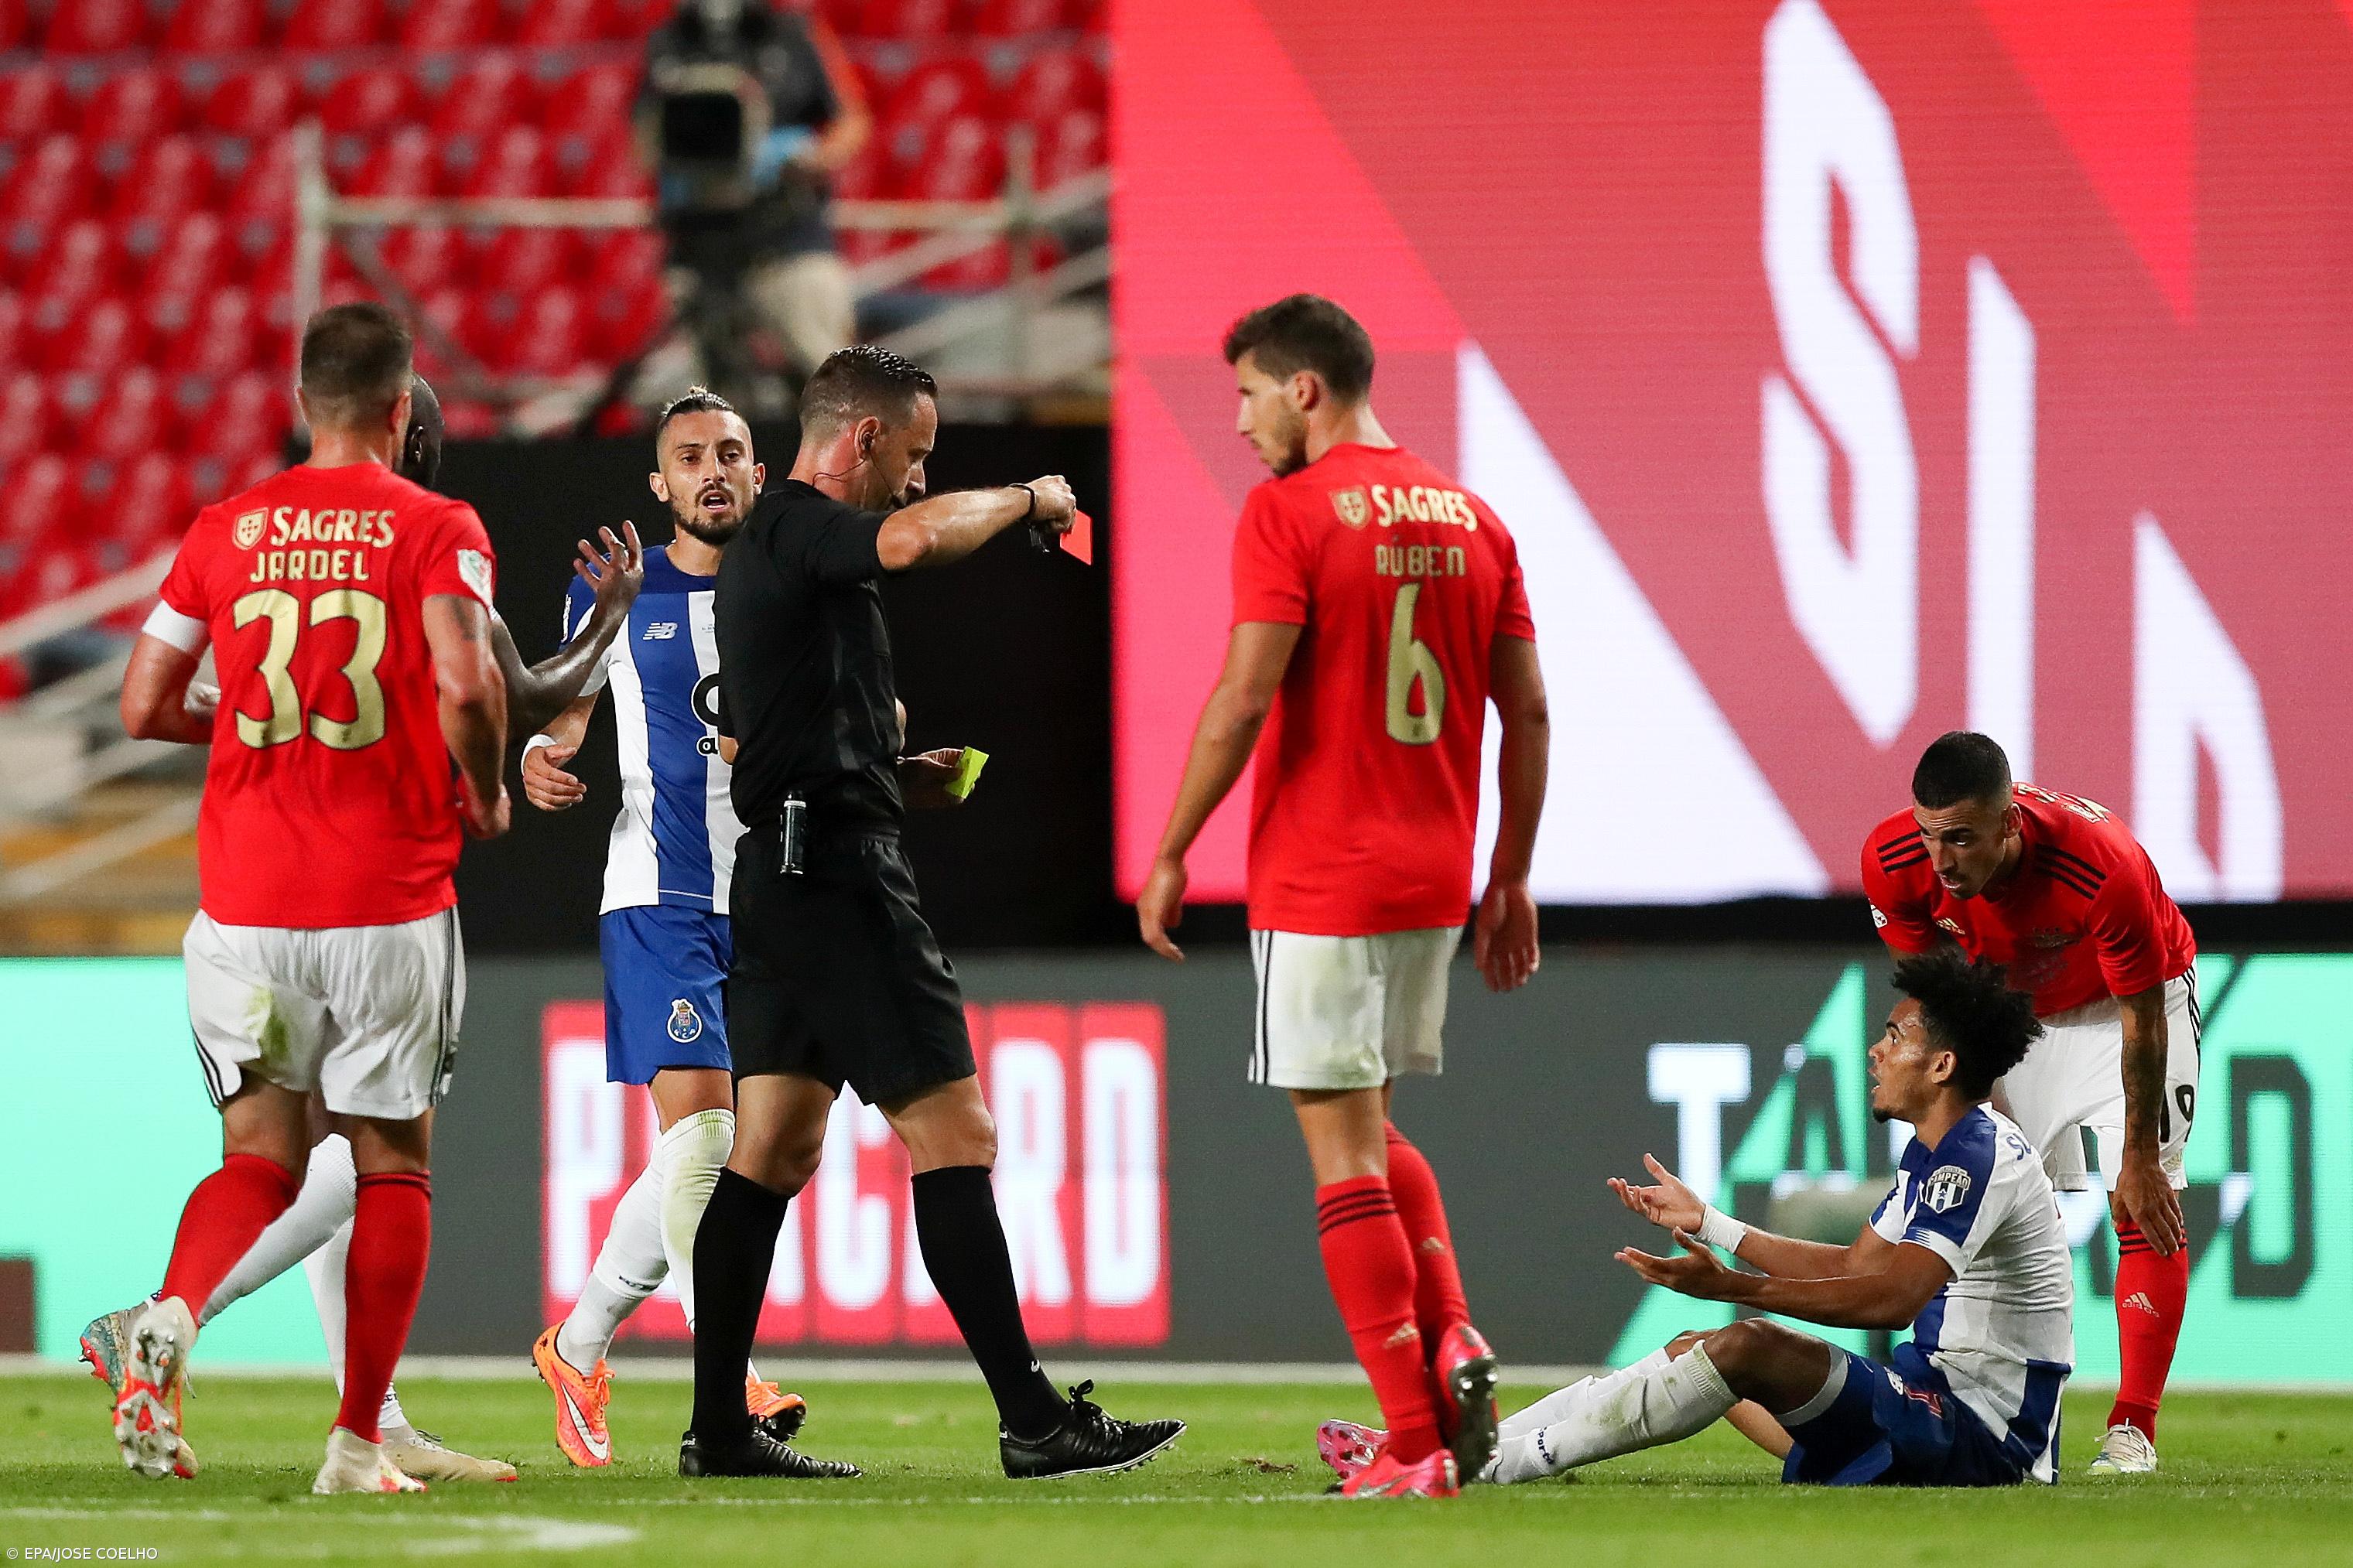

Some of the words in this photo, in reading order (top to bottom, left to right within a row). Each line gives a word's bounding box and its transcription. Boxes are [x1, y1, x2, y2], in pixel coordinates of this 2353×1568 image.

[270, 506, 395, 548] SAGRES
[1371, 483, 1478, 532] SAGRES
[249, 549, 369, 583] JARDEL
[234, 588, 387, 750] 33
[1385, 582, 1447, 746] 6
